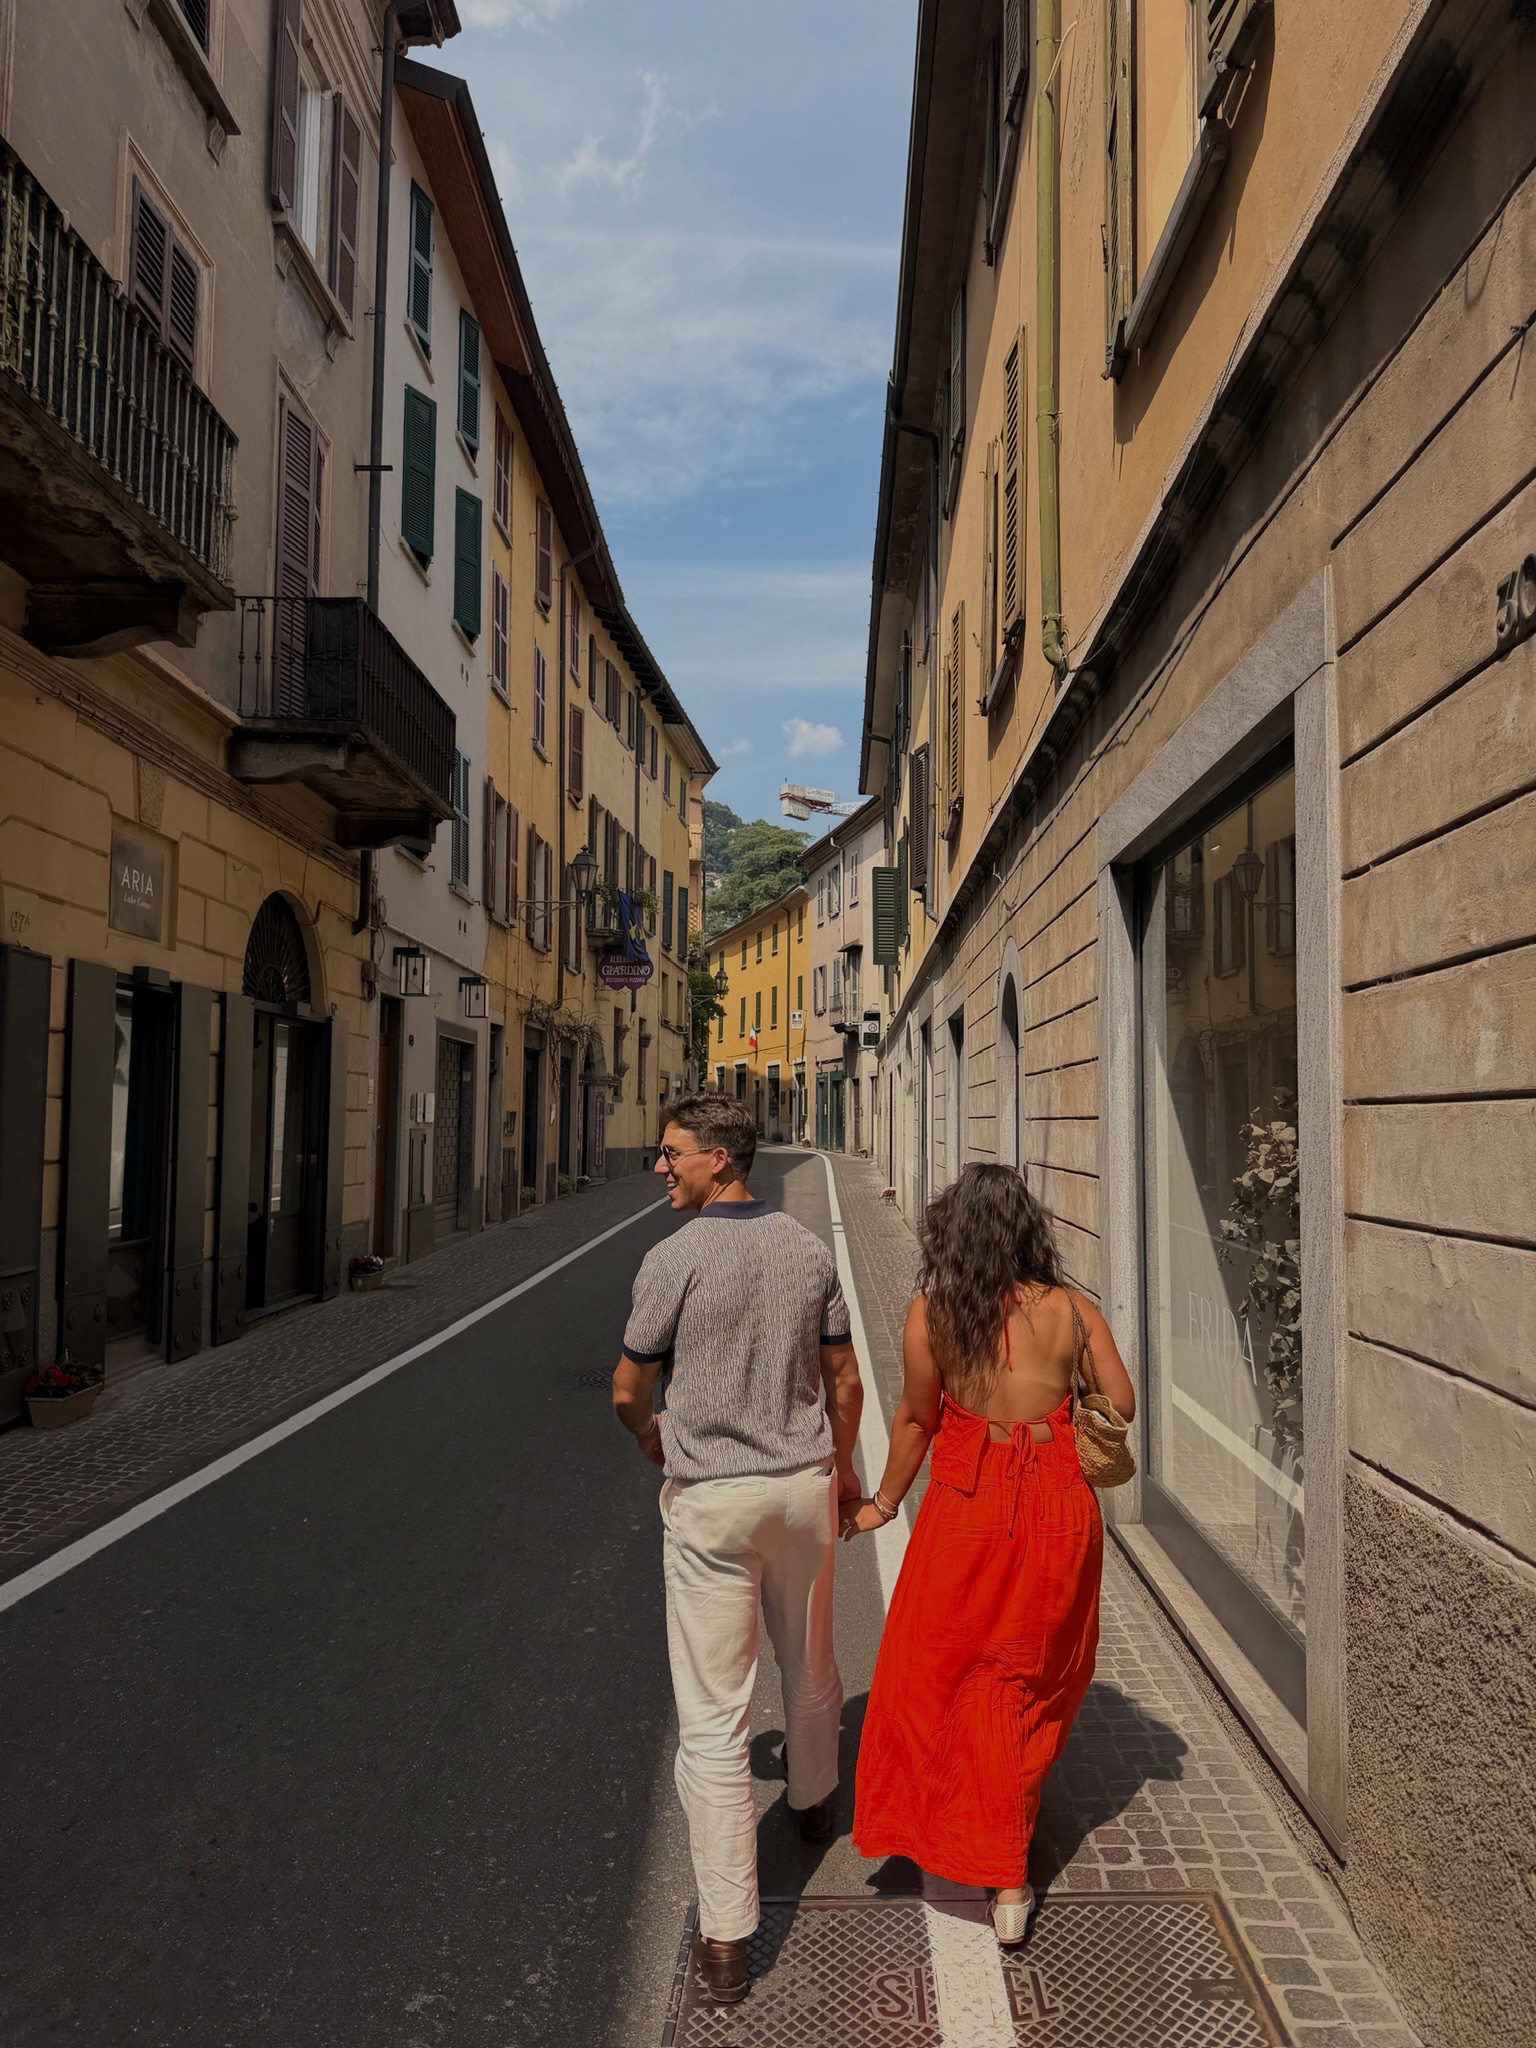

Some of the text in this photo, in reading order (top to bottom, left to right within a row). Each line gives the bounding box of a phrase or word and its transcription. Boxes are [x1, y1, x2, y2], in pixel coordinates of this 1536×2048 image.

[121, 865, 154, 897] ARIA
[602, 965, 651, 976] GIARDINO
[1188, 1290, 1258, 1386] FRIDA
[876, 1966, 1060, 2023] SIEL
